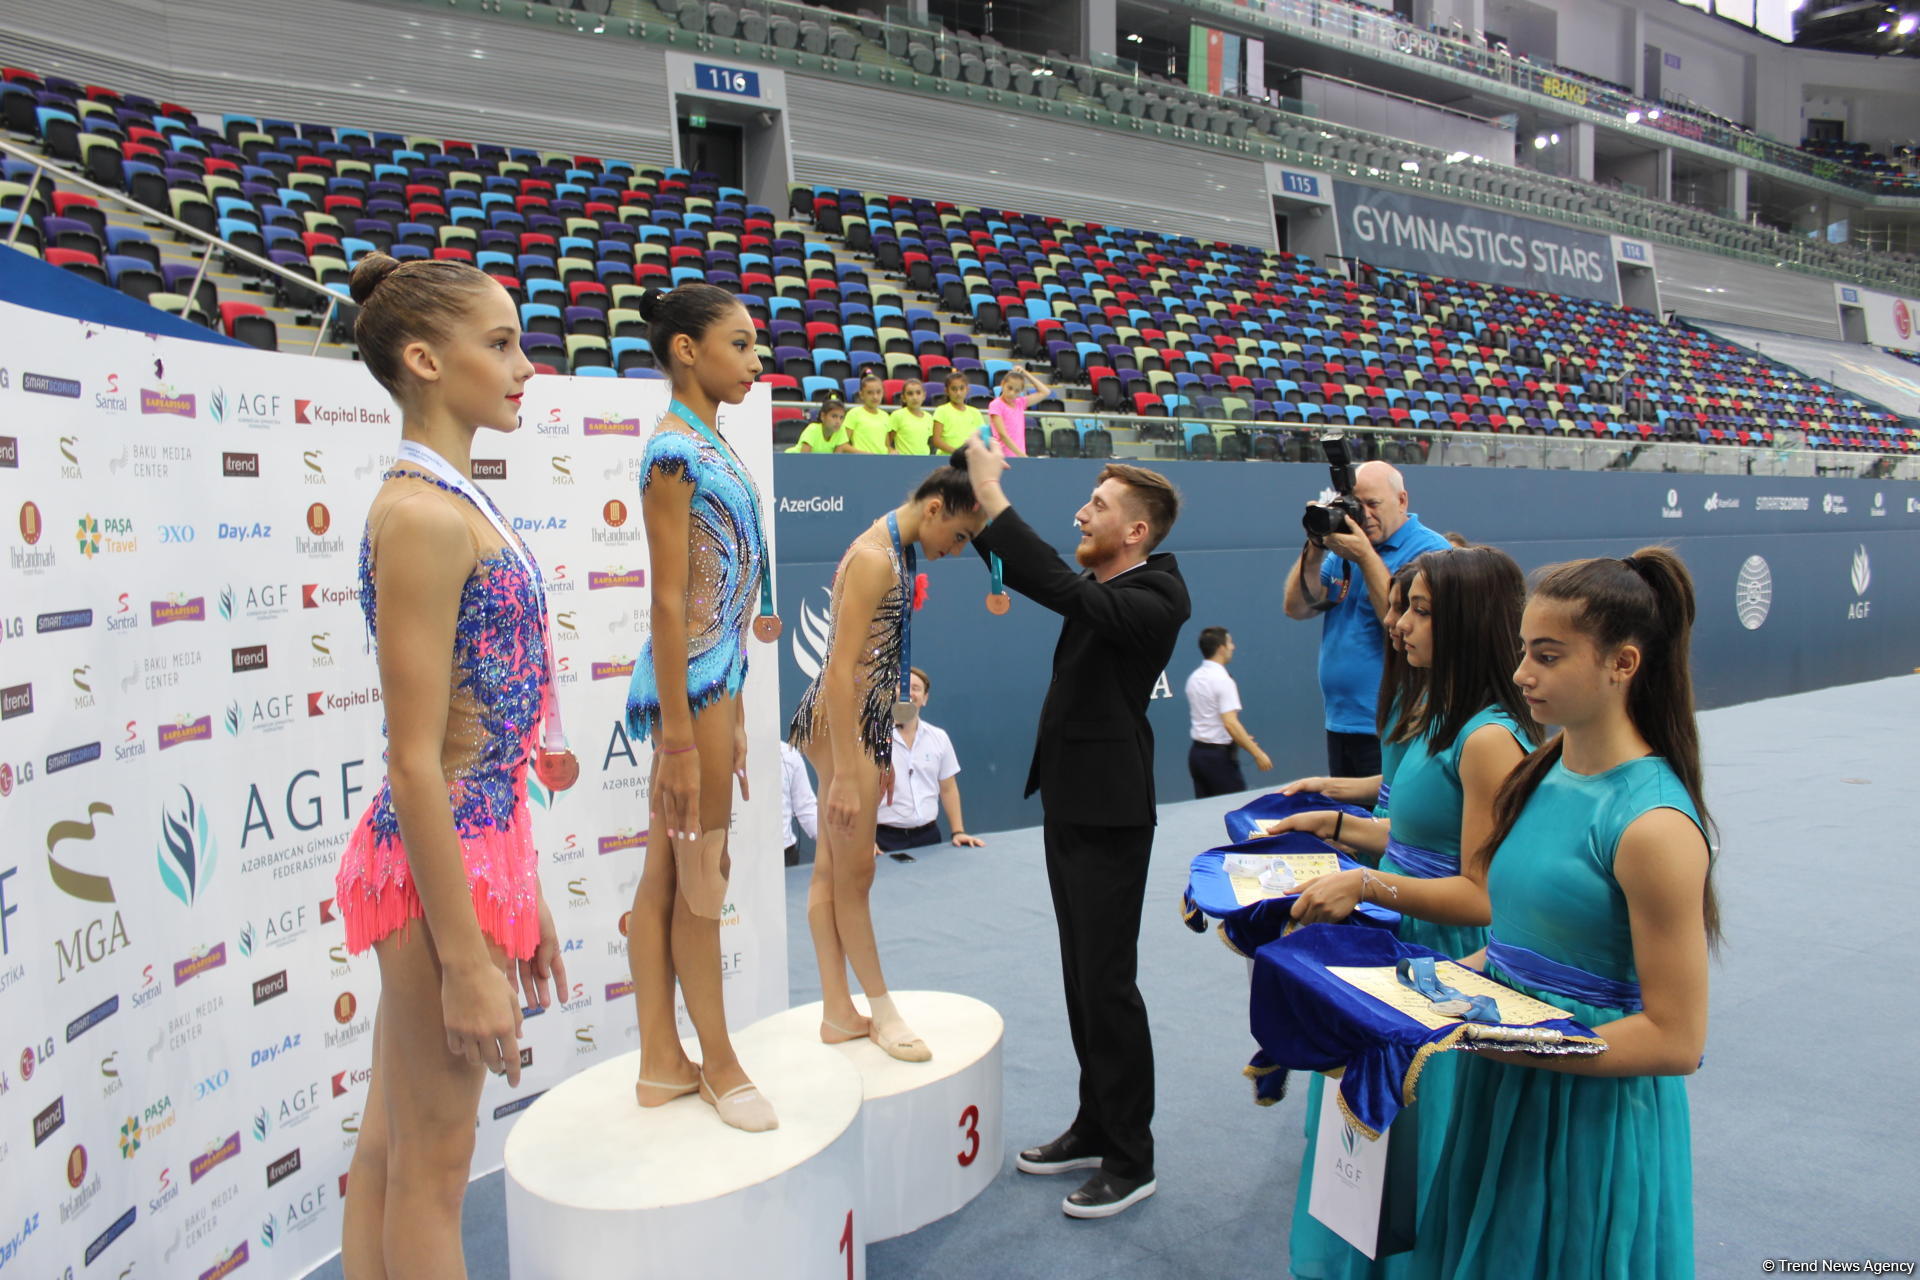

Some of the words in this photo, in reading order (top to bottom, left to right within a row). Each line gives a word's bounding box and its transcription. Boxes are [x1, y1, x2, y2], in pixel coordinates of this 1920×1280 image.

[709, 68, 747, 92] 116
[1543, 77, 1587, 105] #BAKU
[1290, 175, 1311, 193] 115
[1353, 204, 1526, 267] GYMNASTICS
[1532, 242, 1604, 282] STARS
[25, 376, 79, 395] SMARTSCORING
[96, 393, 127, 412] Santral
[238, 393, 280, 417] AGF
[314, 406, 358, 426] Kapital
[361, 407, 391, 425] Bank
[537, 422, 569, 436] Santral
[133, 445, 157, 459] BAKU
[162, 446, 192, 461] MEDIA
[61, 466, 82, 479] MGA
[134, 464, 169, 478] CENTER
[226, 456, 256, 472] trend
[475, 462, 503, 475] trend
[304, 474, 327, 485] MGA
[552, 475, 575, 486] MGA
[780, 496, 843, 512] AzerGold
[1756, 497, 1809, 510] SMARTSCORING
[105, 519, 132, 536] PAŞA
[218, 523, 271, 542] Day.Az
[513, 516, 567, 532] Day.Az
[105, 537, 137, 553] Travel
[246, 584, 288, 608] AGF
[545, 580, 574, 592] antral
[1848, 602, 1870, 619] AGF
[6, 617, 23, 639] LG
[38, 613, 91, 631] SMARTSCORING
[107, 613, 138, 632] Santral
[558, 632, 579, 641] MGA
[145, 656, 167, 672] BAKU
[173, 651, 202, 667] MEDIA
[236, 650, 264, 666] trend
[312, 656, 335, 668] MGA
[146, 674, 180, 690] CENTER
[3, 689, 30, 712] trend
[75, 695, 95, 711] MGA
[252, 694, 294, 721] AGF
[327, 688, 369, 712] Kapital
[115, 741, 146, 761] Santral
[17, 762, 33, 785] LG
[240, 759, 364, 849] AGF
[241, 845, 304, 874] AZƏRBAYCAN
[553, 848, 585, 864] Santral
[273, 854, 336, 880] FEDERASİYASI
[569, 898, 591, 909] MGA
[266, 906, 306, 940] AGF
[55, 910, 131, 984] MGA
[132, 982, 162, 1009] Santral
[255, 974, 284, 1000] trend
[168, 1012, 192, 1034] BAKU
[196, 996, 225, 1019] MEDIA
[170, 1024, 203, 1050] CENTER
[38, 1036, 55, 1065] LG
[251, 1033, 301, 1068] Day.Az
[145, 1096, 172, 1122] PAŞA
[279, 1083, 319, 1120] AGF
[37, 1101, 62, 1138] trend
[146, 1111, 177, 1140] Travel
[958, 1105, 980, 1167] 3
[270, 1154, 298, 1181] trend
[1336, 1157, 1362, 1182] AGF
[287, 1184, 326, 1225] AGF
[840, 1208, 853, 1280] 1
